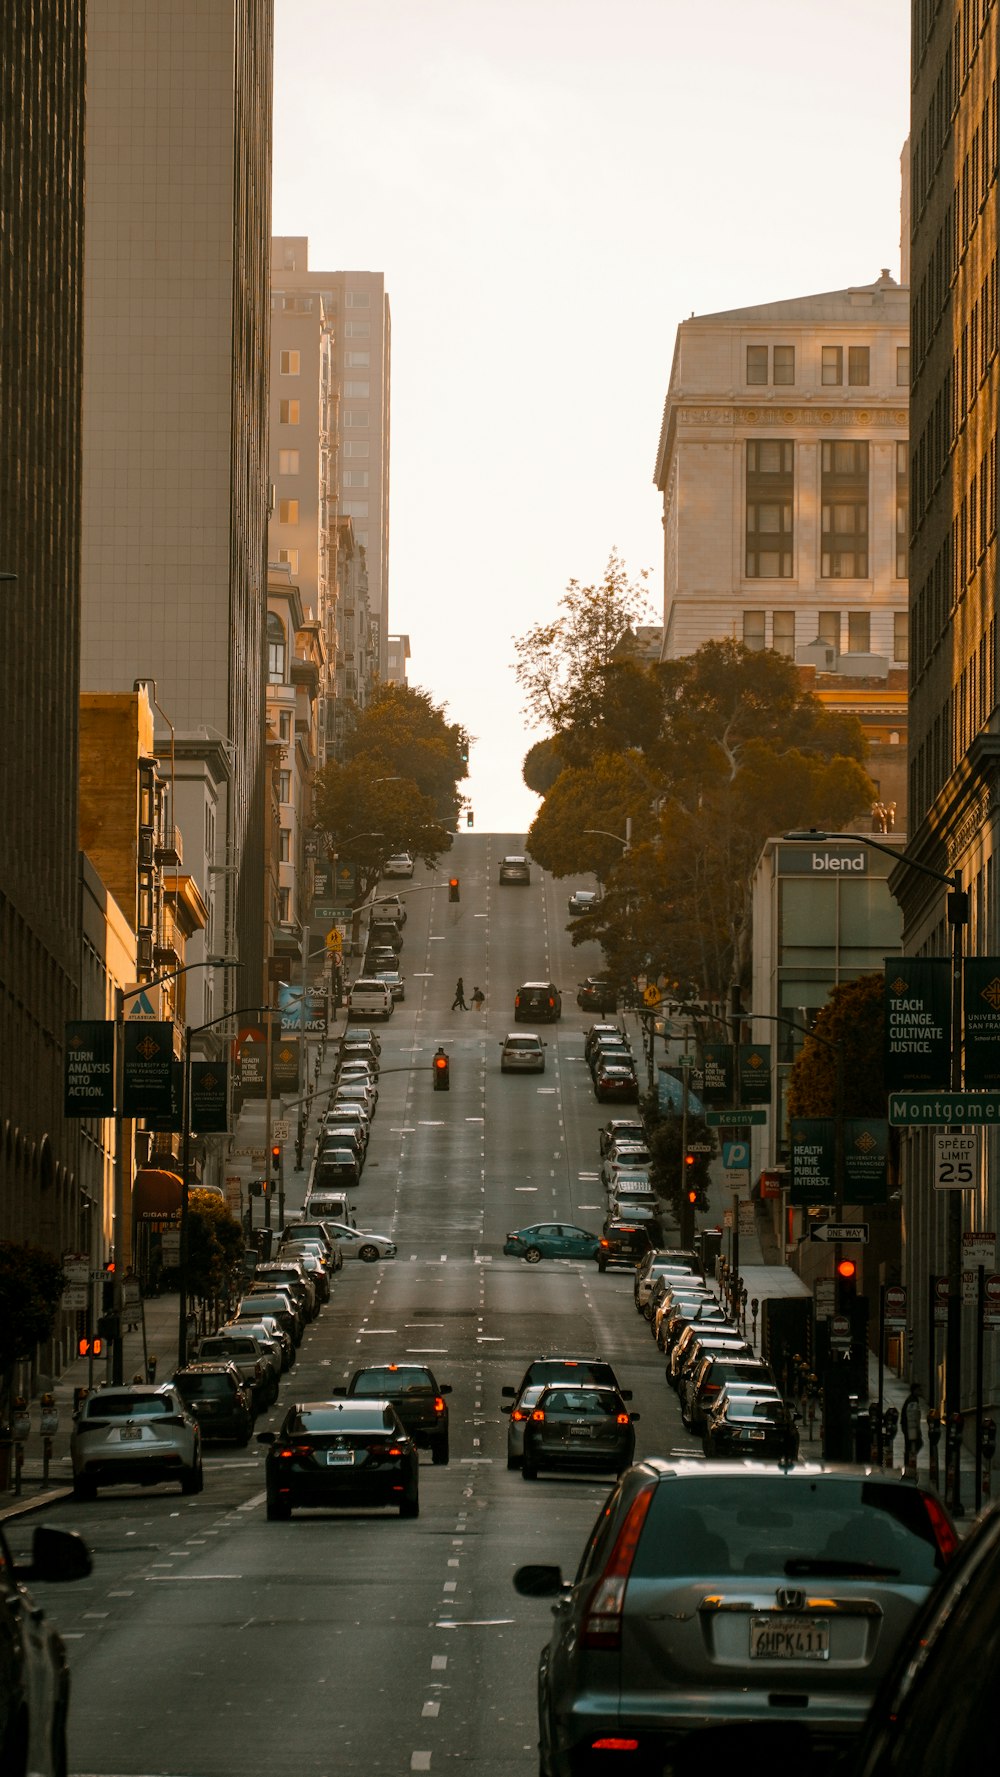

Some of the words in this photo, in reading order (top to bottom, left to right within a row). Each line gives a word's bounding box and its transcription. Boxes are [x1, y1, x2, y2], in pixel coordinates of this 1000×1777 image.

[812, 853, 865, 870] blend
[890, 999, 923, 1011] TEACH
[281, 1018, 326, 1030] SHARKS
[890, 1013, 935, 1025] CHANGE.
[890, 1027, 943, 1039] CULTIVATE
[889, 1041, 932, 1053] JUSTICE.
[68, 1052, 94, 1061] TURN
[68, 1063, 111, 1073] ANALYSIS
[68, 1075, 90, 1085] INTO
[68, 1087, 104, 1096] ACTION.
[893, 1101, 1000, 1122] Montgome
[719, 1114, 753, 1124] Kearny
[275, 1130, 288, 1138] 25
[938, 1140, 975, 1149] SPEED
[793, 1146, 823, 1154] HEALTH
[793, 1156, 802, 1165] IN
[802, 1156, 819, 1165] THE
[942, 1152, 970, 1160] LIMIT
[793, 1166, 821, 1175] PUBLIC
[939, 1163, 973, 1182] 25
[793, 1177, 831, 1186] INTEREST.
[757, 1632, 823, 1652] 6HPK411
